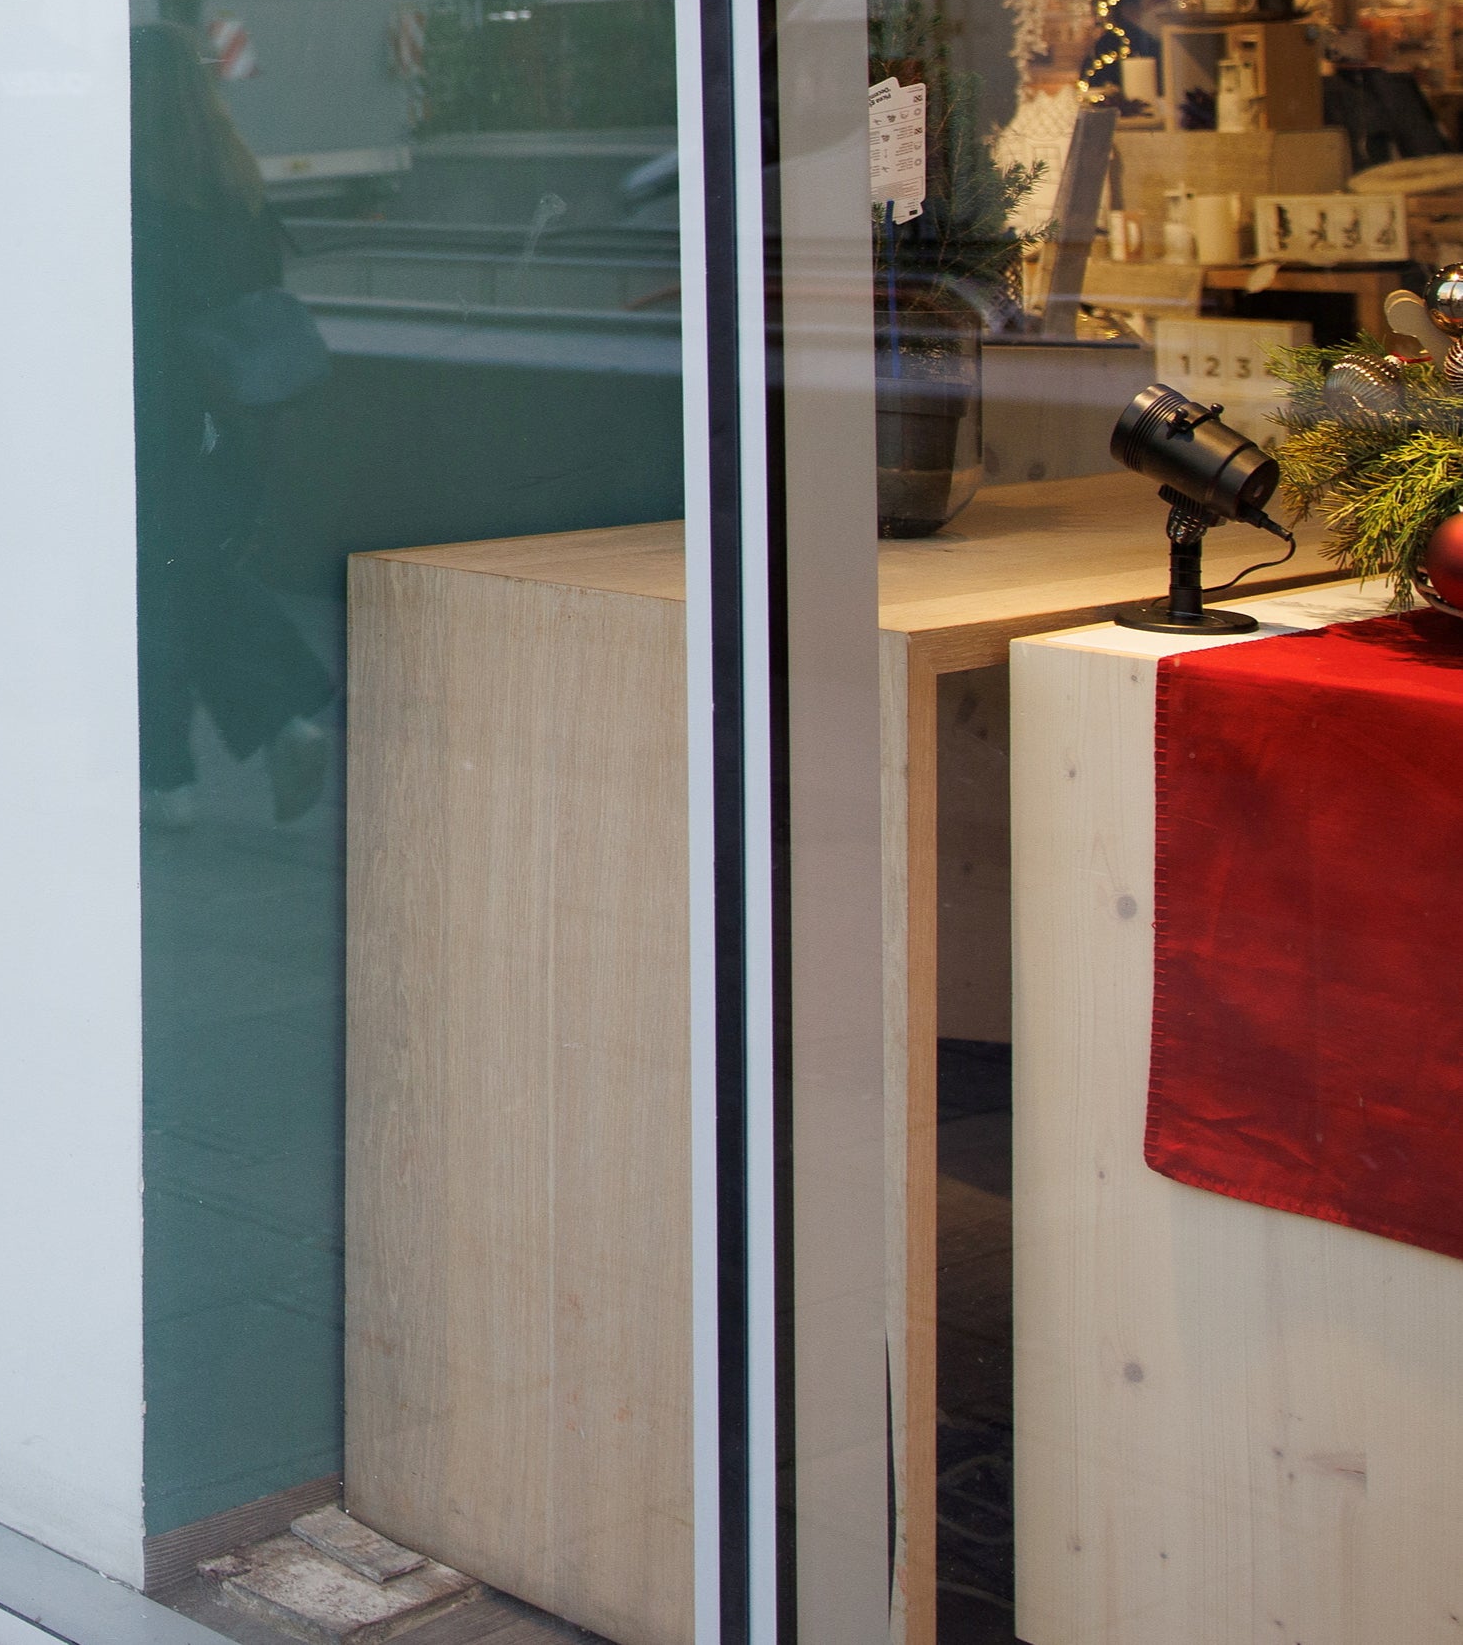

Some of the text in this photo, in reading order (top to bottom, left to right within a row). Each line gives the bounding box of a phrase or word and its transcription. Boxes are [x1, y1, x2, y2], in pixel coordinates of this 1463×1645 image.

[1181, 355, 1253, 379] 1 2 3
